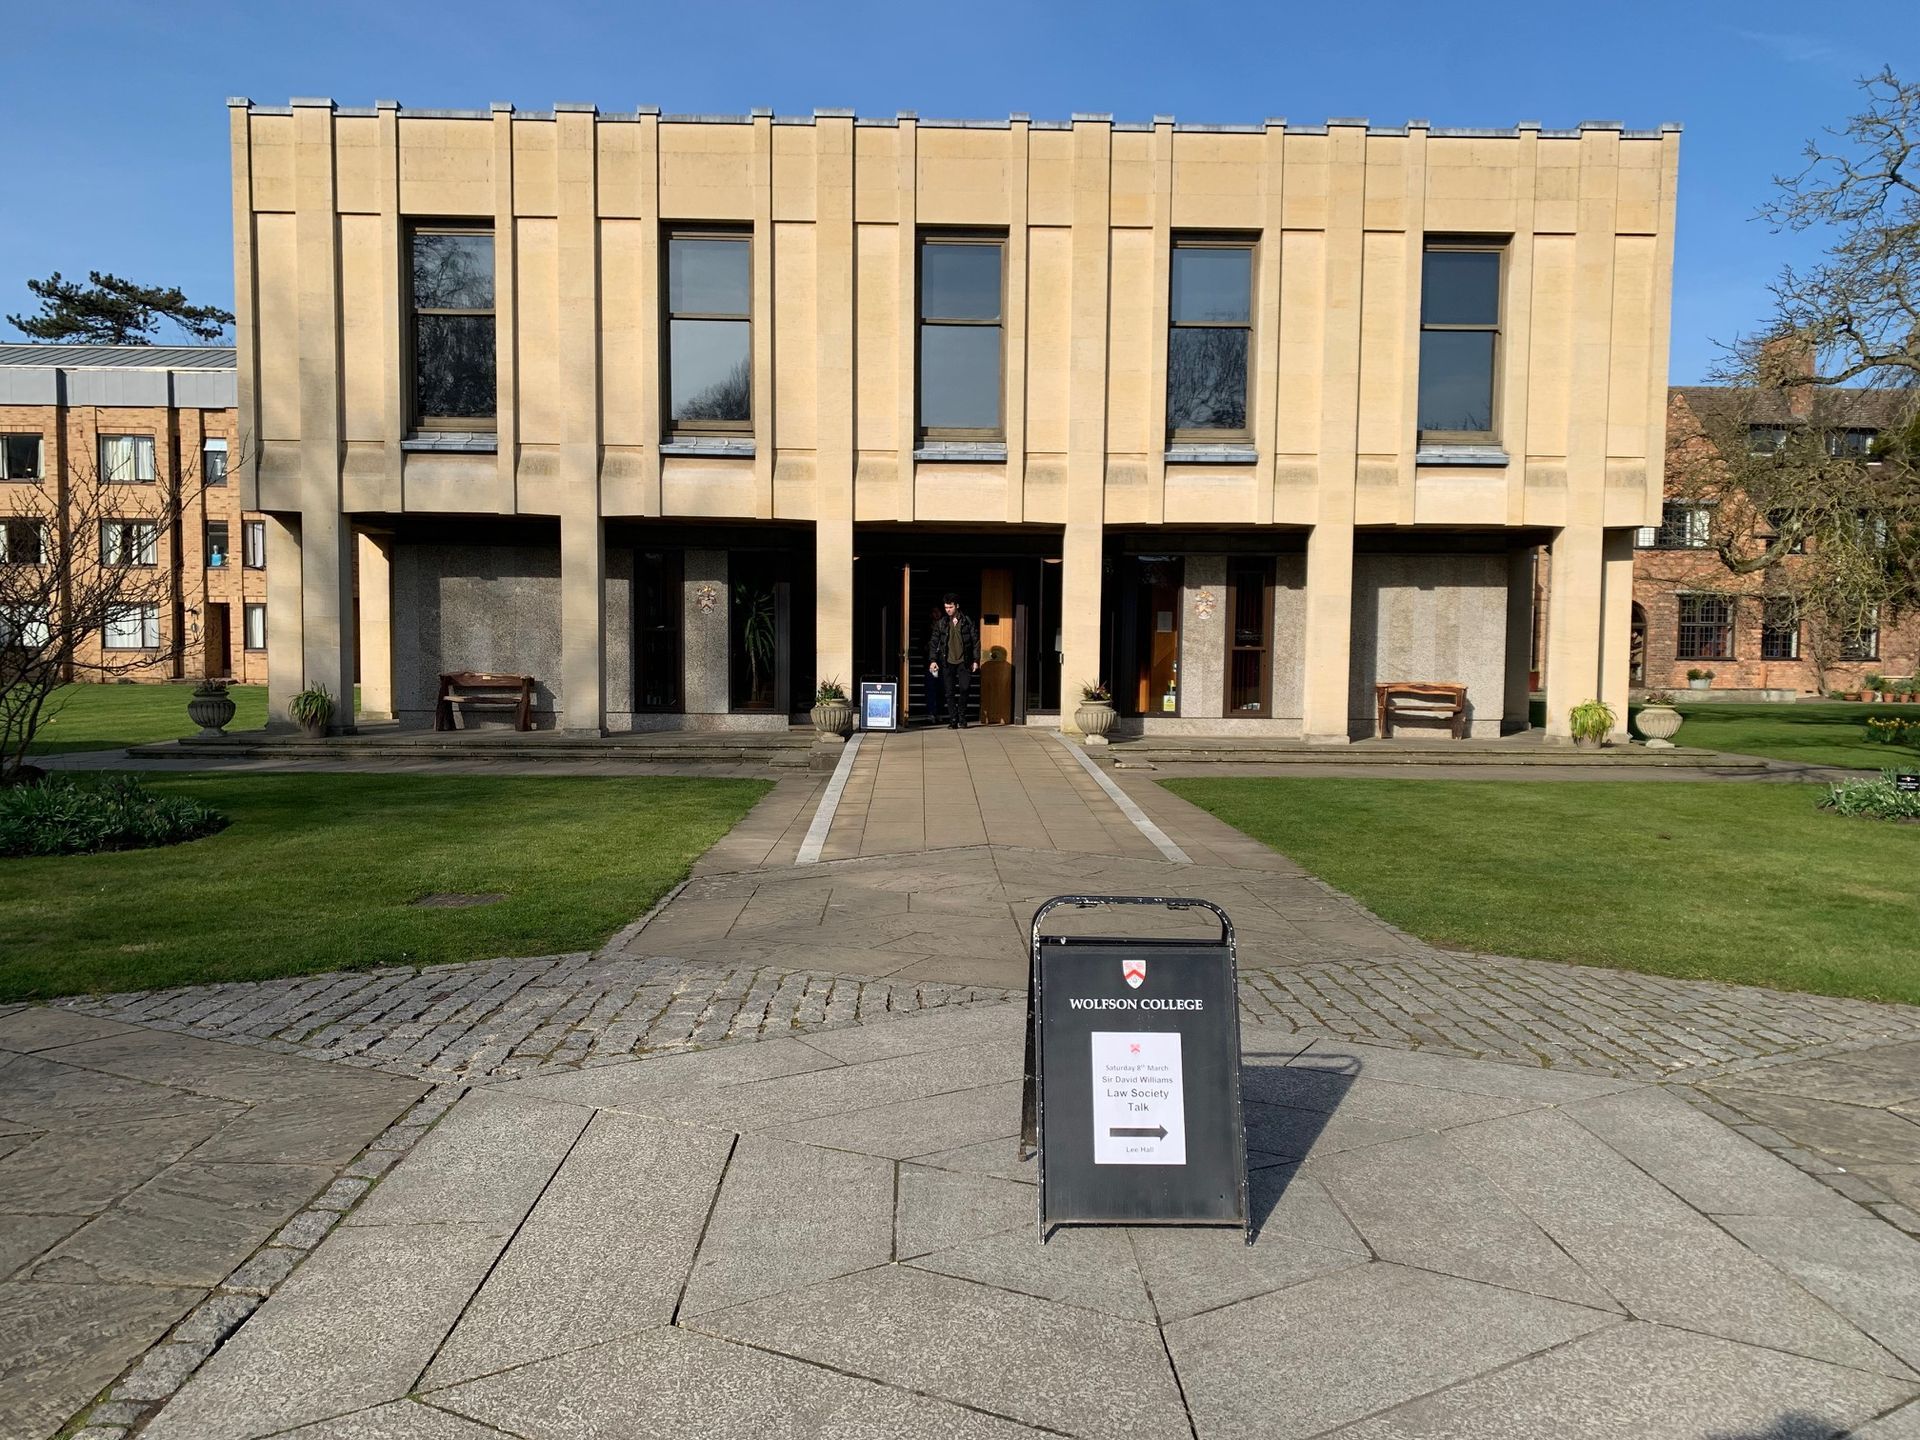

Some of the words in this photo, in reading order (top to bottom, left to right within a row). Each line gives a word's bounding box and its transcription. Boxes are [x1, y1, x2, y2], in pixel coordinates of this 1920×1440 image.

[1069, 998, 1138, 1010] WOLFSON
[1140, 998, 1204, 1010] COLLEGE
[1105, 1064, 1135, 1072] Saturday
[1139, 1076, 1174, 1084] Williams
[1107, 1088, 1128, 1097] Law
[1131, 1088, 1169, 1100] Society
[1127, 1102, 1150, 1112] Talk
